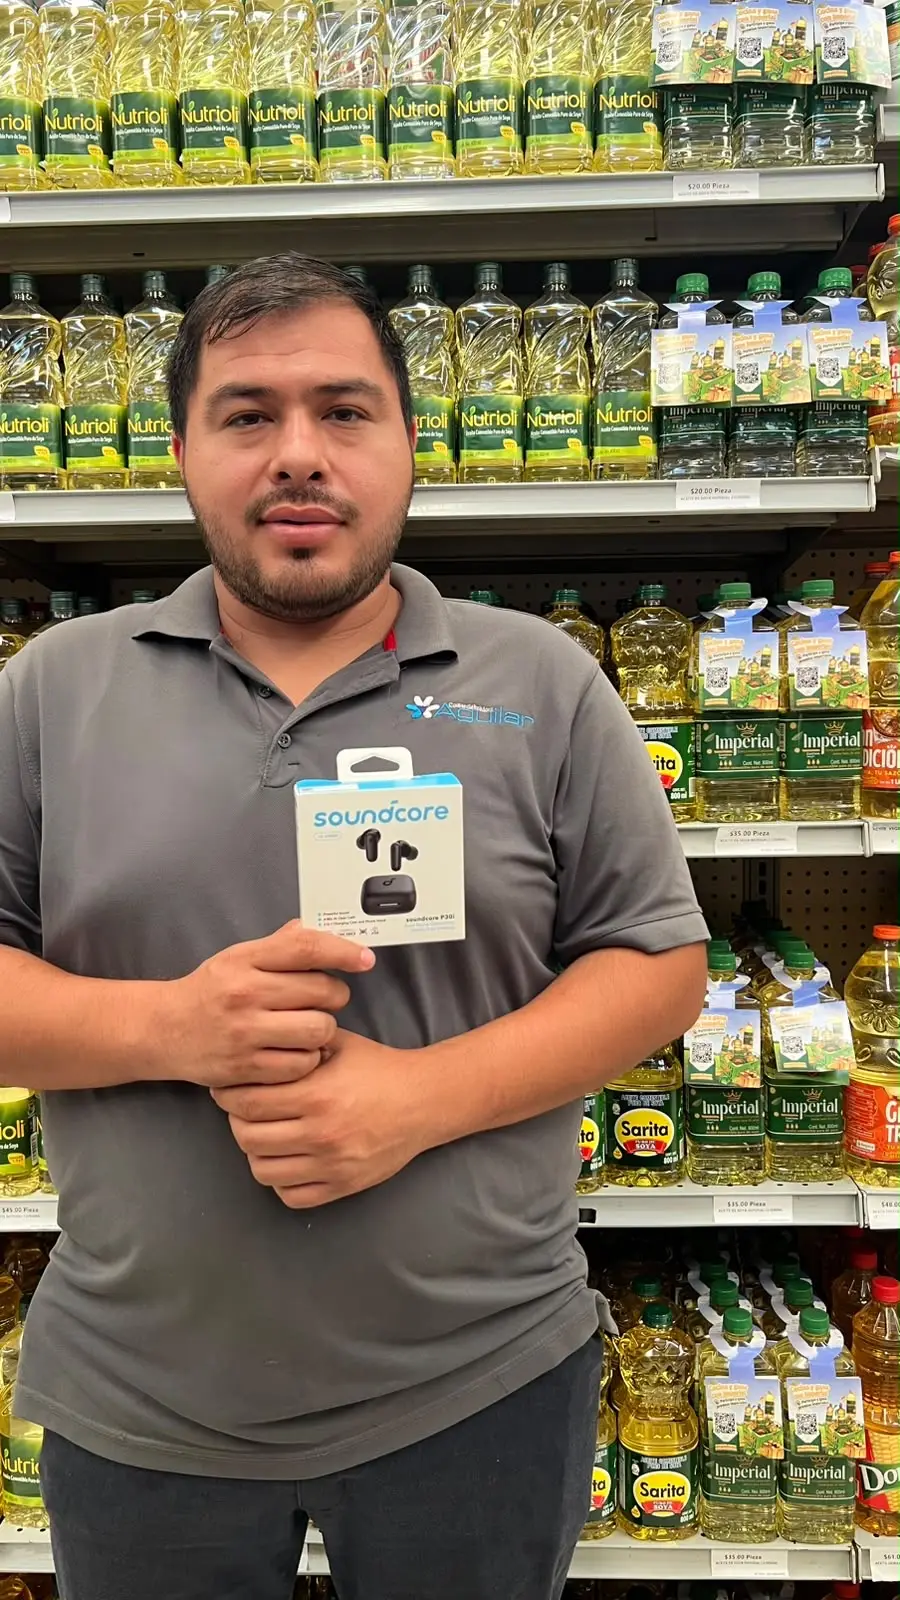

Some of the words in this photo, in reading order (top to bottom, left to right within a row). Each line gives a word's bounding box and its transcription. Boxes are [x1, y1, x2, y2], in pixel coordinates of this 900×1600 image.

[390, 100, 447, 120] Nutrioli
[458, 95, 515, 116] Nutrioli
[528, 91, 586, 112] Nutrioli
[600, 91, 657, 111] Nutrioli
[0, 114, 32, 132] rioli
[45, 114, 103, 132] Nutrioli
[112, 107, 167, 127] Nutrioli
[182, 106, 239, 125] Nutrioli
[250, 103, 304, 123] Nutrioli
[320, 104, 375, 125] Nutrioli
[128, 418, 172, 433] Nutrio
[416, 413, 448, 428] trioli
[462, 410, 517, 427] Nutrioli
[527, 410, 583, 428] Nutrioli
[597, 407, 652, 424] Nutrioli
[65, 418, 117, 436] Nutrioli
[433, 703, 535, 728] Aguilar
[716, 733, 773, 755] Imperial
[804, 731, 860, 754] Imperial
[653, 755, 675, 770] ita
[314, 800, 448, 827] soundcore
[703, 1100, 758, 1121] Imperial
[782, 1098, 838, 1120] Imperial
[886, 1100, 900, 1123] G
[0, 1120, 24, 1140] ioli
[622, 1121, 668, 1136] Sarita
[716, 1463, 771, 1484] Imperial
[790, 1463, 845, 1484] Imperial
[859, 1464, 900, 1491] Do
[593, 1480, 605, 1492] ta
[640, 1482, 685, 1498] Sarita
